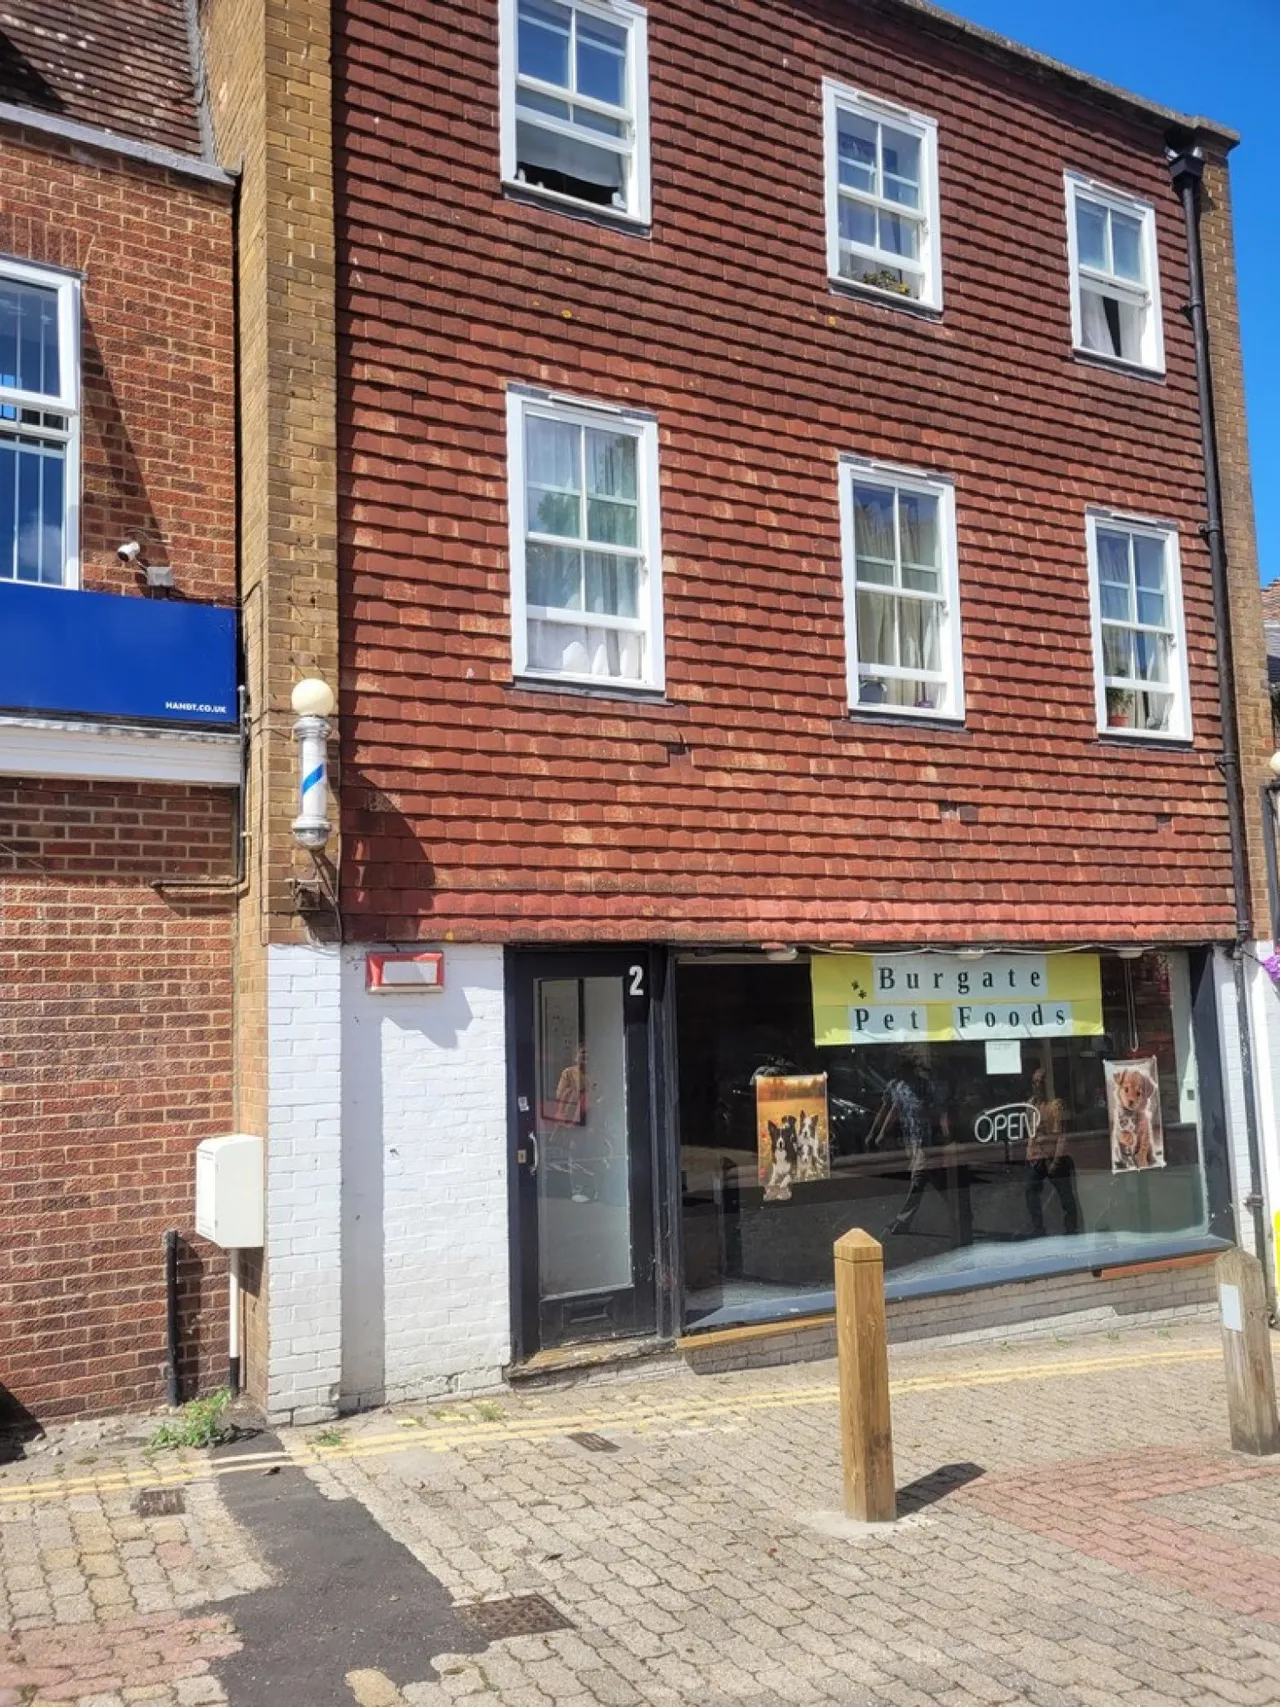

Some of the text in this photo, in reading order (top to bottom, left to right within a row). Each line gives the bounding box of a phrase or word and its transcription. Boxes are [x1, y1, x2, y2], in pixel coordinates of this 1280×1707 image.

[629, 965, 644, 995] 2
[878, 967, 1041, 994] Burgate
[853, 1004, 1066, 1031] Pet Foods
[974, 1112, 1037, 1142] OPEN
